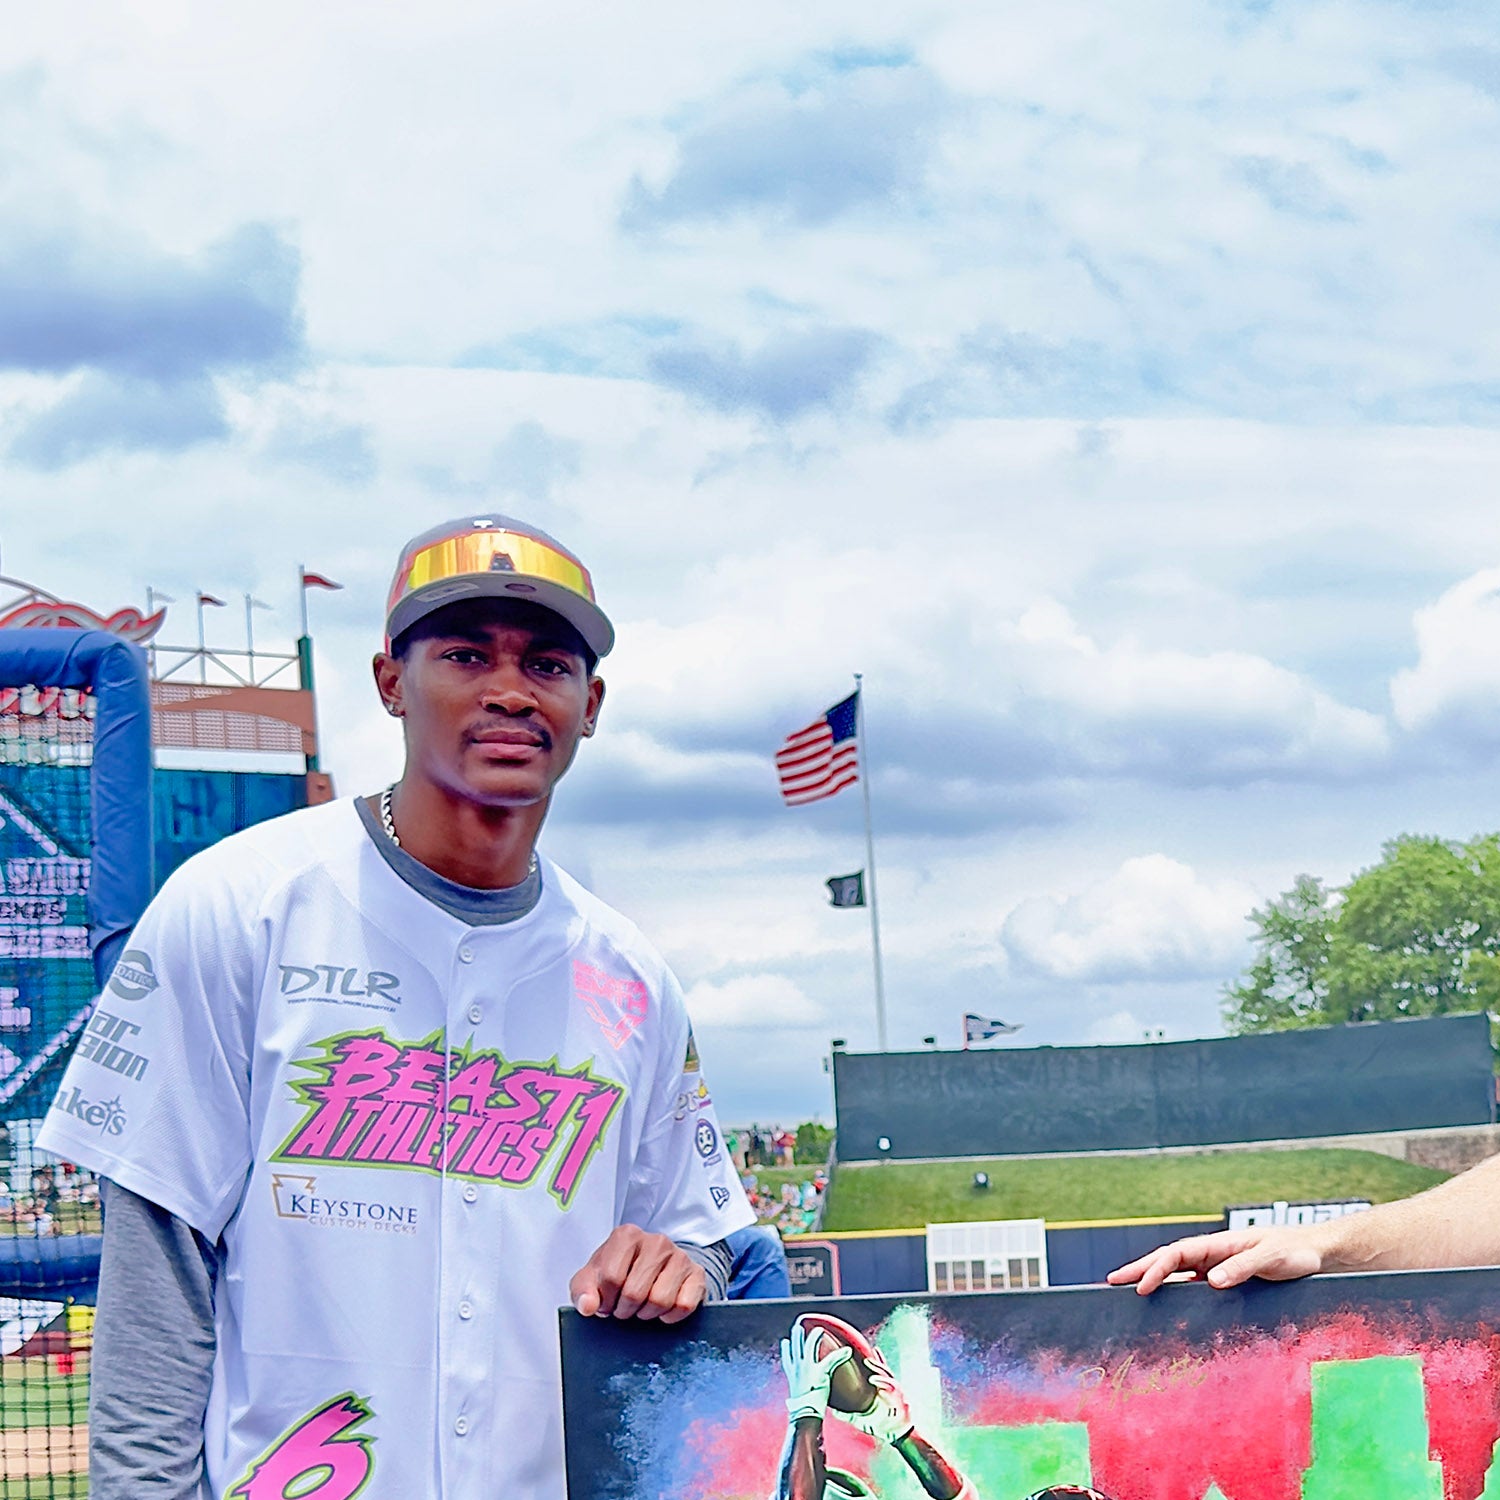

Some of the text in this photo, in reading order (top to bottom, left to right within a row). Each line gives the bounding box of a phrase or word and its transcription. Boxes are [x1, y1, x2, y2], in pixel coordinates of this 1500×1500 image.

[278, 964, 402, 1004] DTLR
[286, 1088, 555, 1182] ATHLETICS
[290, 1194, 418, 1225] KEYSTONE
[308, 1216, 418, 1235] CUSTOM DECKS
